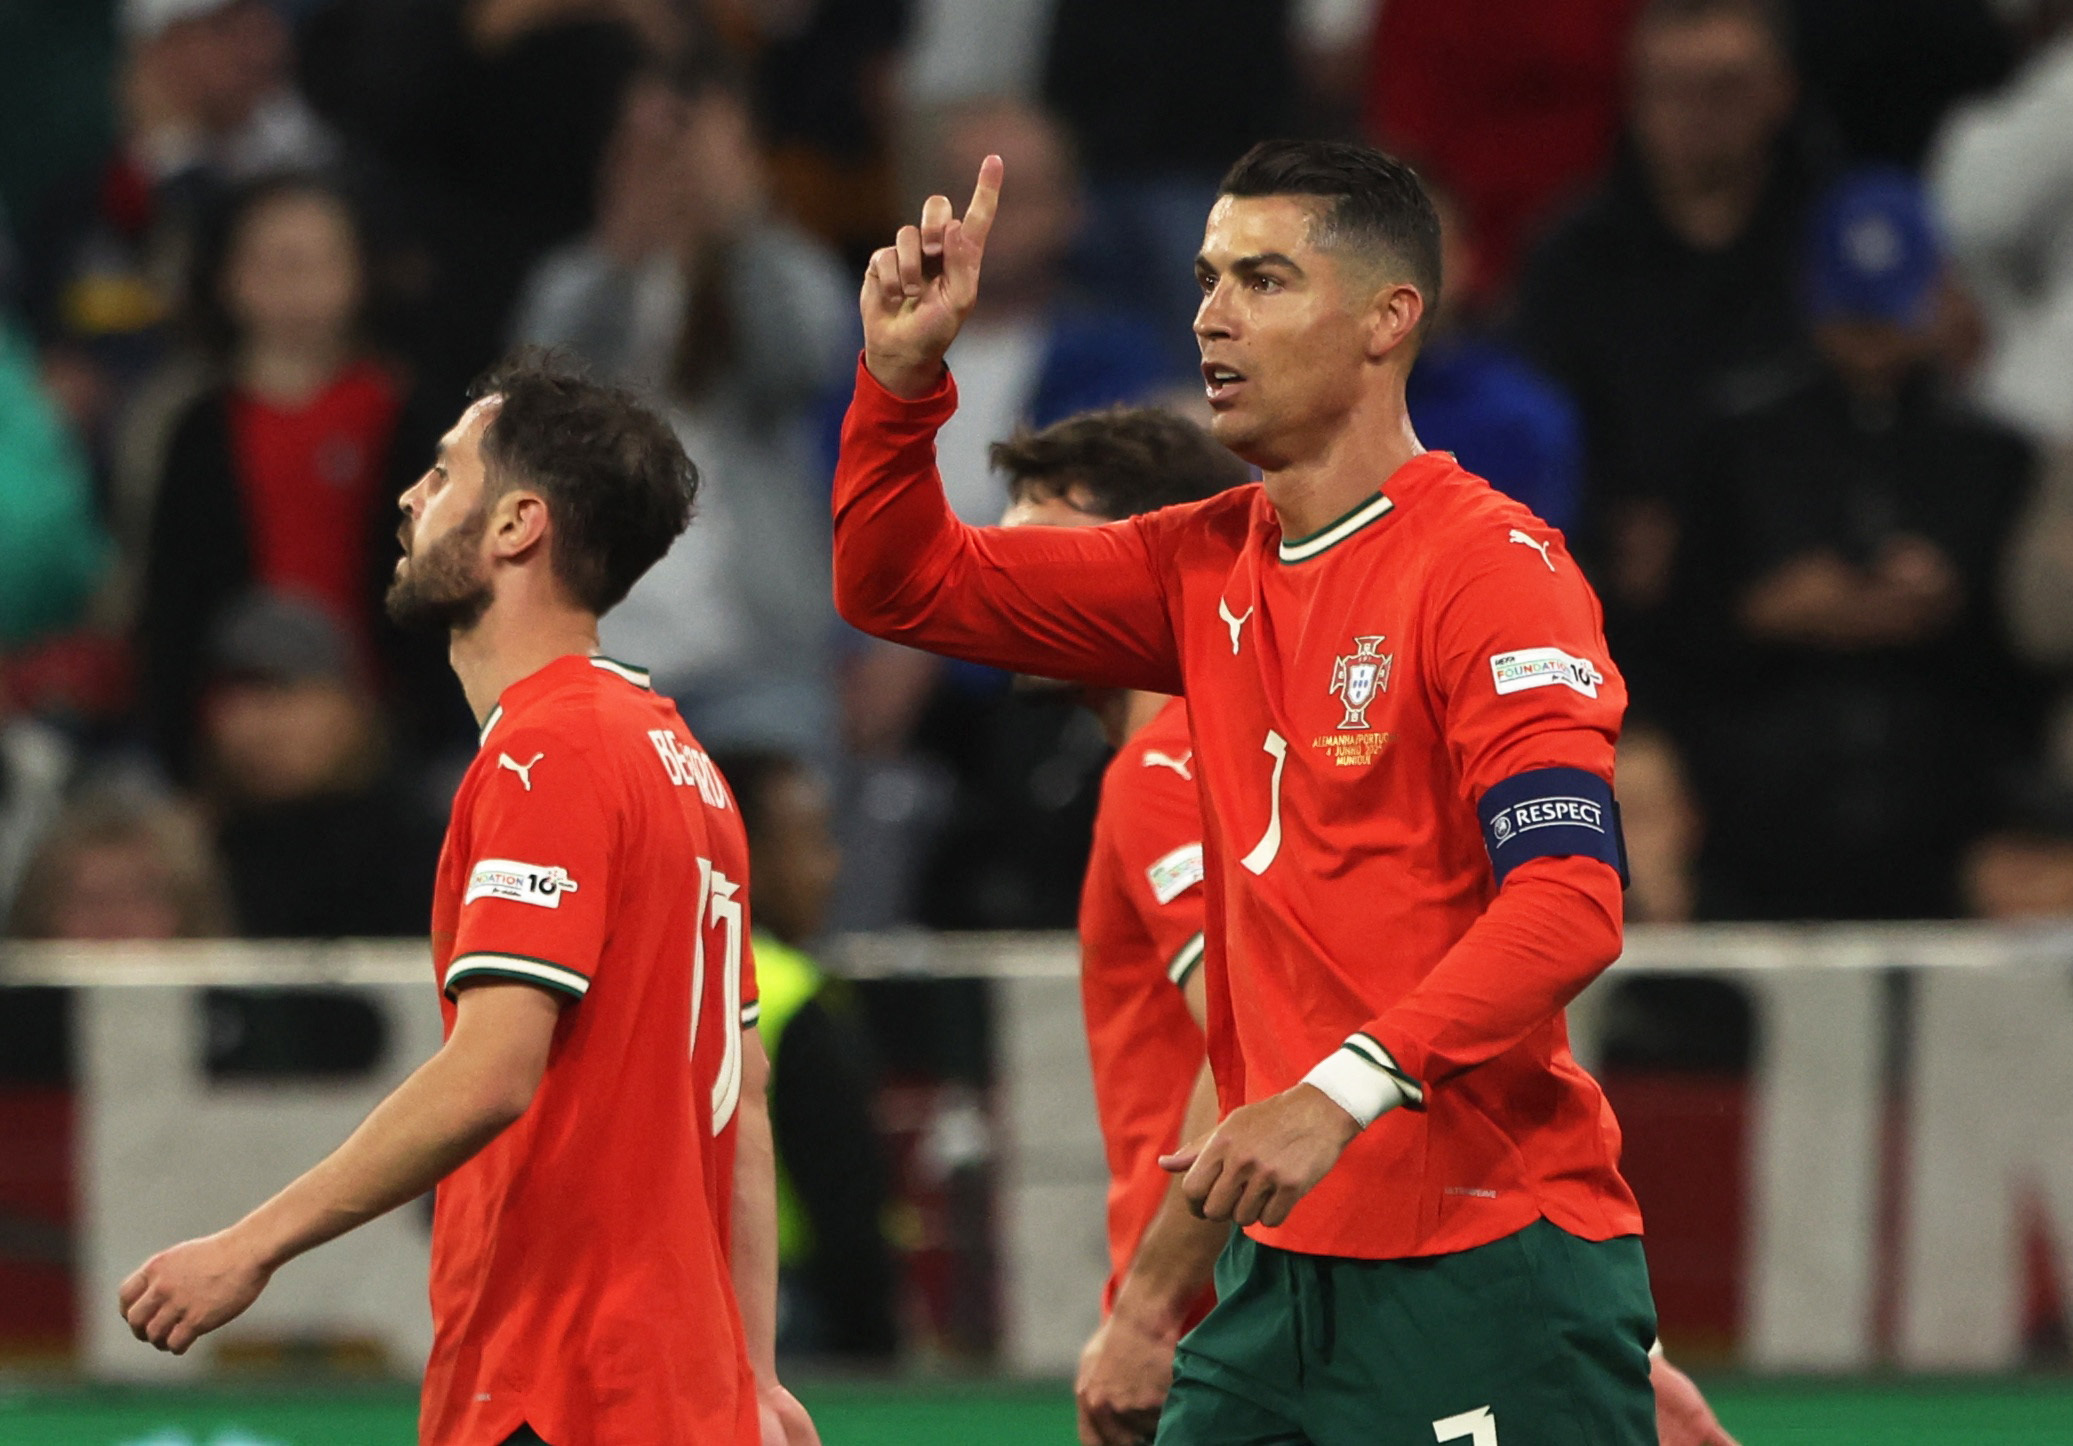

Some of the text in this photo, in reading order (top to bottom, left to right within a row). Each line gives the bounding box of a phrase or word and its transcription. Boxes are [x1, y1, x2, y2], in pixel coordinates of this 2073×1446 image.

[1240, 729, 1288, 876] 7
[1516, 802, 1601, 827] RESPECT
[528, 874, 557, 895] 10
